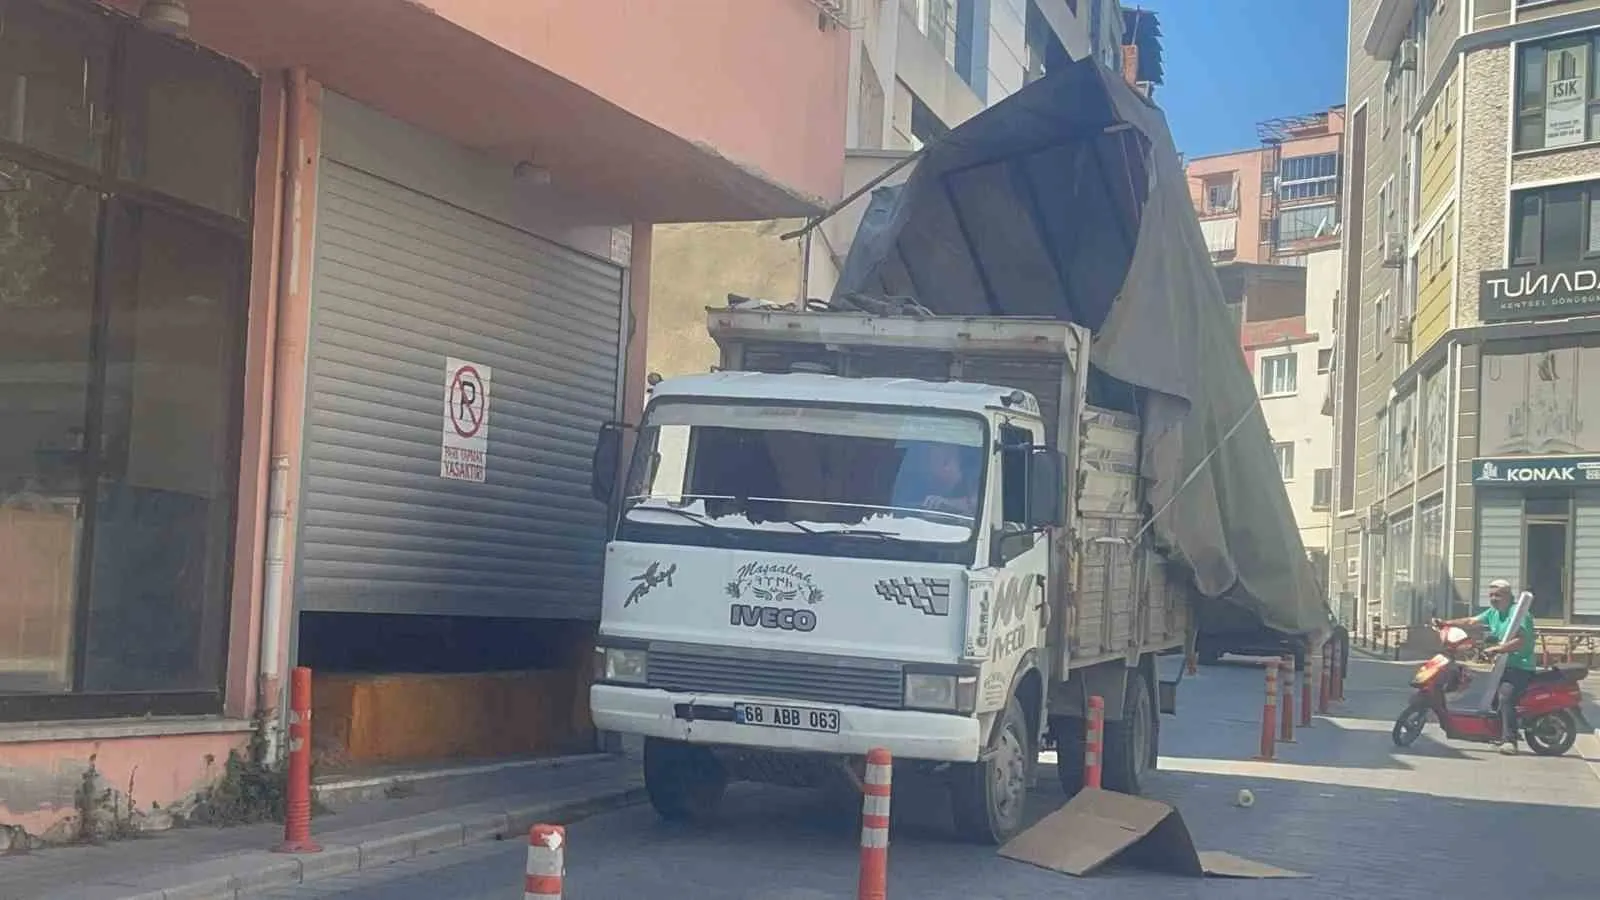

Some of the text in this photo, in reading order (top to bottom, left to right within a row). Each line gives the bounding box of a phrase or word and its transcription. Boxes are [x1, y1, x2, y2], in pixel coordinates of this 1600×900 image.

[1486, 270, 1600, 298] TUNAD
[1507, 467, 1575, 481] KONAK
[730, 603, 817, 632] IVECO
[745, 706, 837, 730] 68 ABB 063
